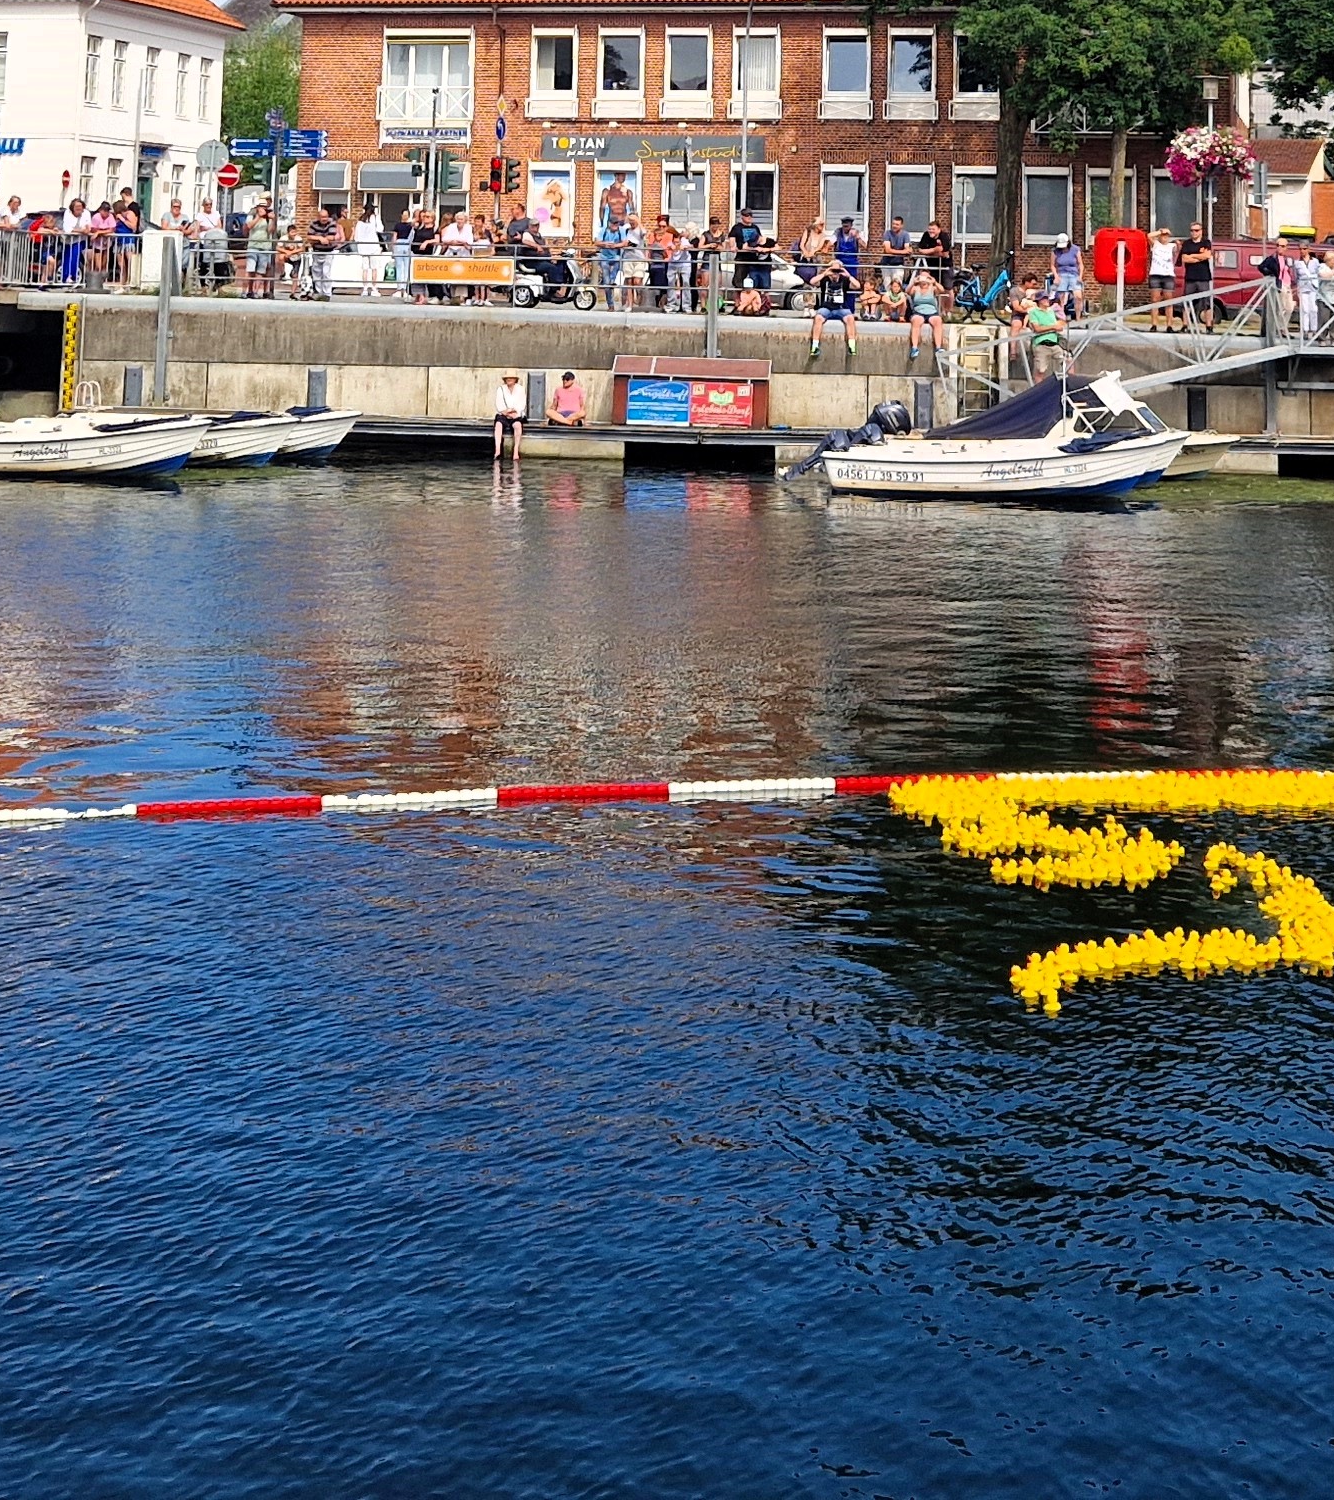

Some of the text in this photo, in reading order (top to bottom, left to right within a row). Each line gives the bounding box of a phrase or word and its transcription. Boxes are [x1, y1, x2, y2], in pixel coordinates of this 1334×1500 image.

[552, 137, 605, 149] TOP TAN
[634, 140, 754, 159] Sonnnstudi
[468, 263, 499, 273] shuttle
[837, 468, 868, 481] 04561
[879, 470, 892, 481] 39
[896, 471, 908, 482] 59
[912, 472, 924, 482] 91
[980, 460, 1044, 479] Angeltreff
